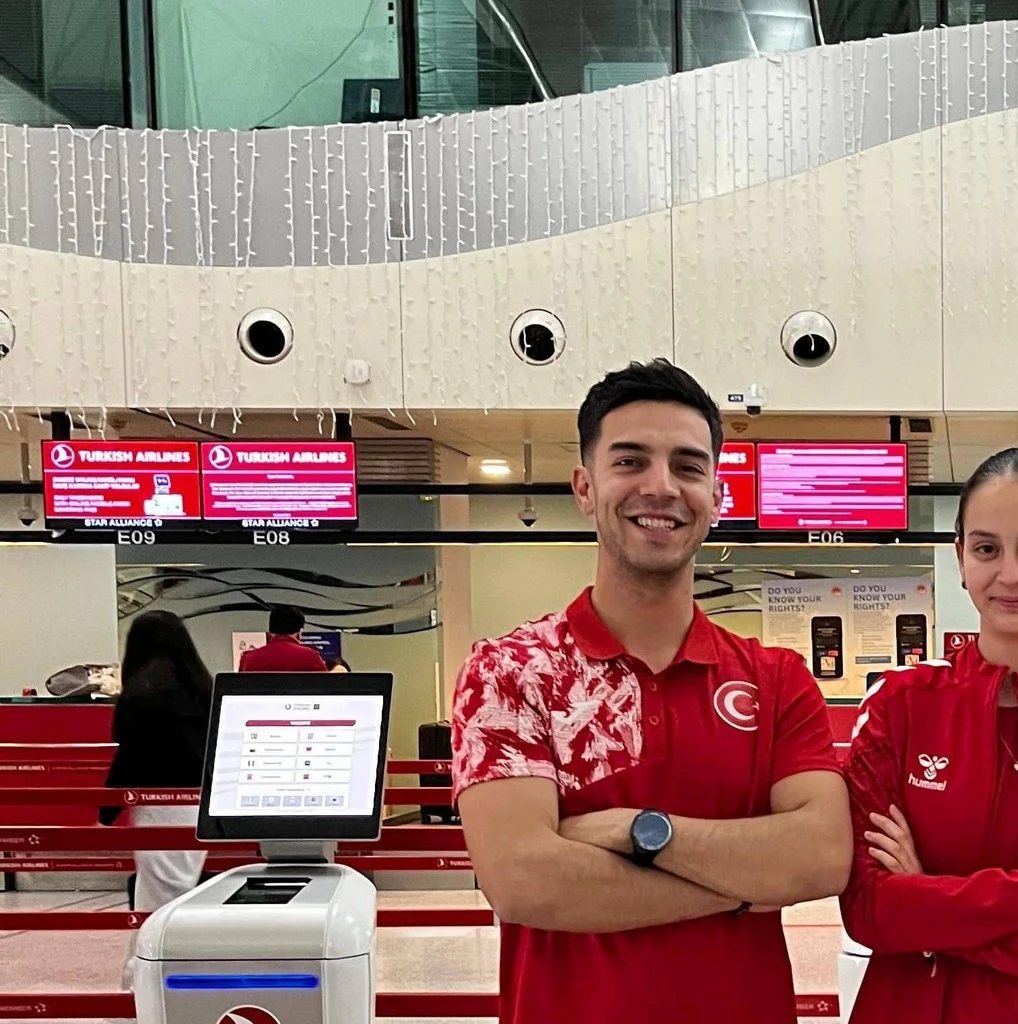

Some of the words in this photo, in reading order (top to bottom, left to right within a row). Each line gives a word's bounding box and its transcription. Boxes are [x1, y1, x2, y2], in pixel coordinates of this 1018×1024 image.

[78, 450, 132, 463] TURKISH
[135, 451, 191, 463] AIRLINES
[236, 451, 290, 463] TURKISH
[292, 451, 347, 463] AIRLINES
[84, 519, 108, 527] STAR
[108, 519, 153, 527] ALLIANCE
[242, 519, 265, 527] STAR
[266, 519, 310, 527] ALLIANCE
[117, 530, 156, 545] E09
[253, 530, 290, 545] E08
[808, 531, 844, 543] E06
[768, 587, 782, 595] DO
[853, 585, 866, 593] DO
[768, 596, 796, 604] KNOW
[797, 595, 822, 603] YOUR
[853, 593, 880, 601] KNOW
[882, 593, 906, 601] YOUR
[768, 604, 805, 613] RIGHTS?
[853, 602, 890, 610] RIGHTS?
[908, 772, 947, 791] hummel
